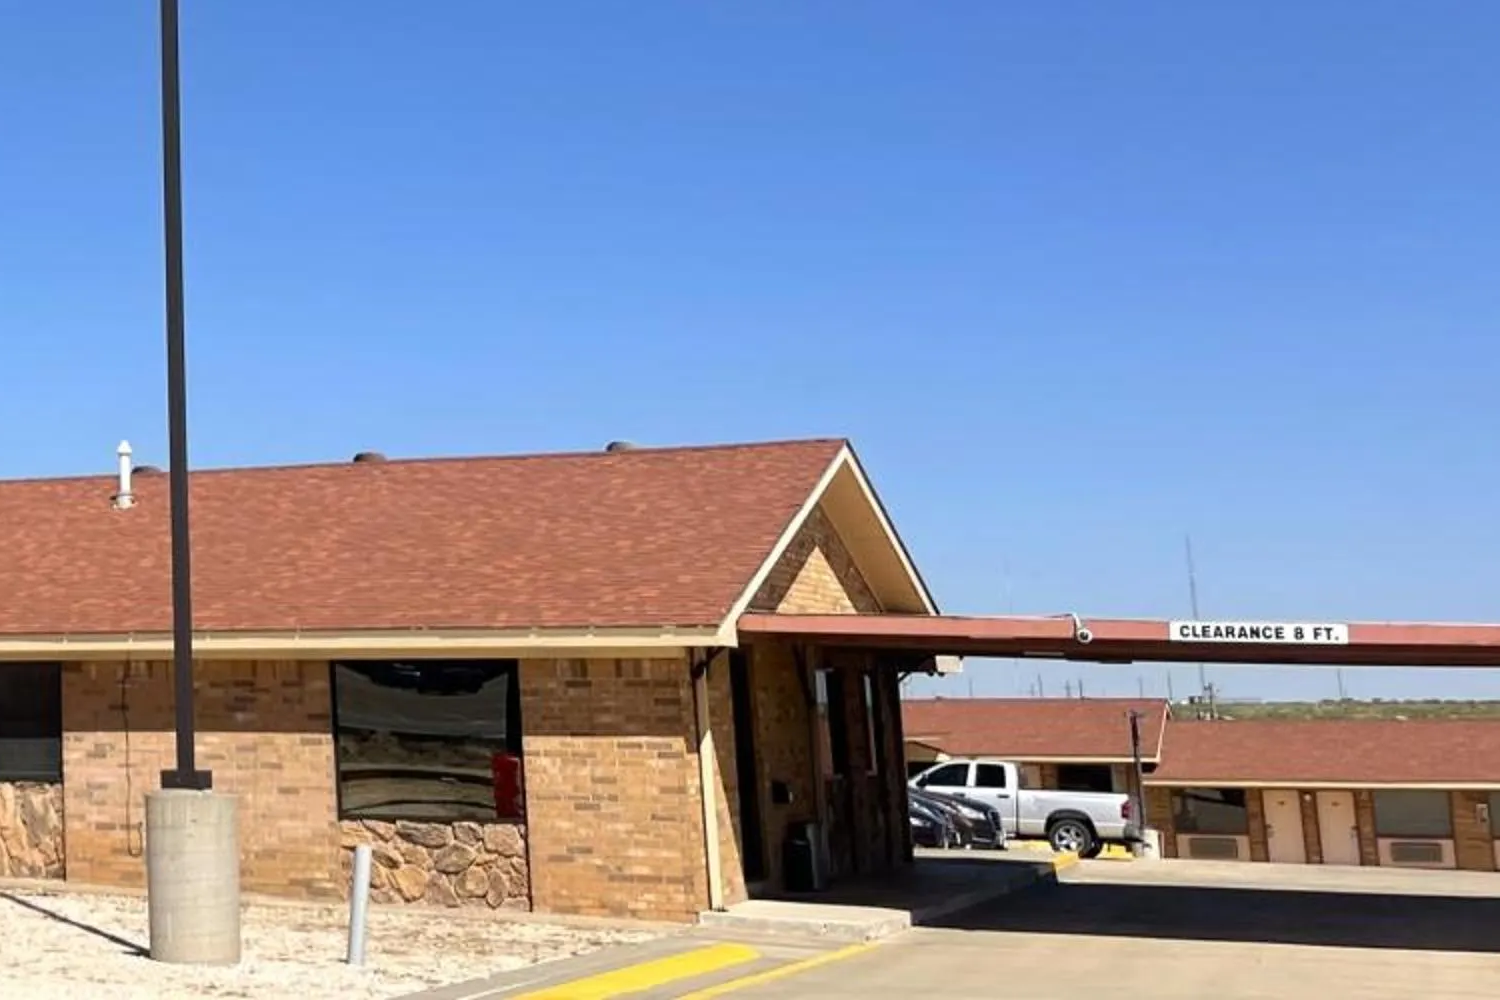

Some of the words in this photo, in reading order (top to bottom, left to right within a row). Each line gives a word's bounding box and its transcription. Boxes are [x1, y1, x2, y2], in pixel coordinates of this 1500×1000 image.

[1179, 625, 1285, 640] CLEARANCE
[1294, 626, 1305, 640] 8
[1313, 627, 1340, 641] FT.
